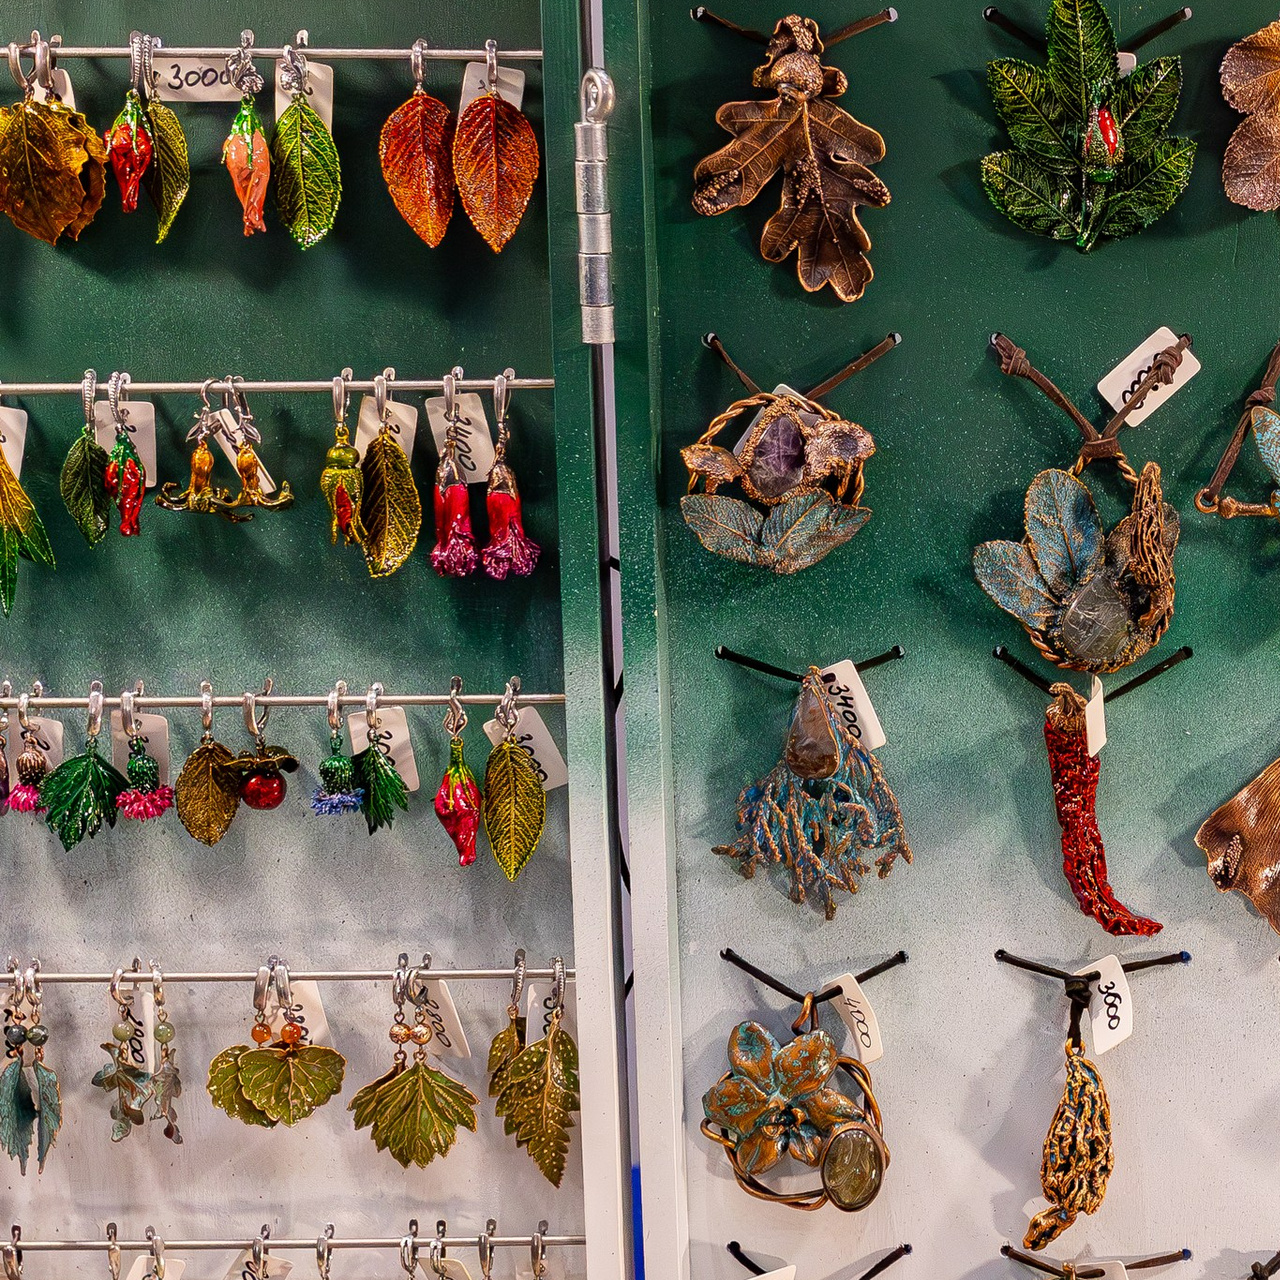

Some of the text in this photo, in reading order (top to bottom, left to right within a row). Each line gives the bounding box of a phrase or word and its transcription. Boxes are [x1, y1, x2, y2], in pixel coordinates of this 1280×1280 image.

[828, 684, 861, 739] 3400
[844, 997, 871, 1048] 4000
[1098, 981, 1121, 1030] 3600
